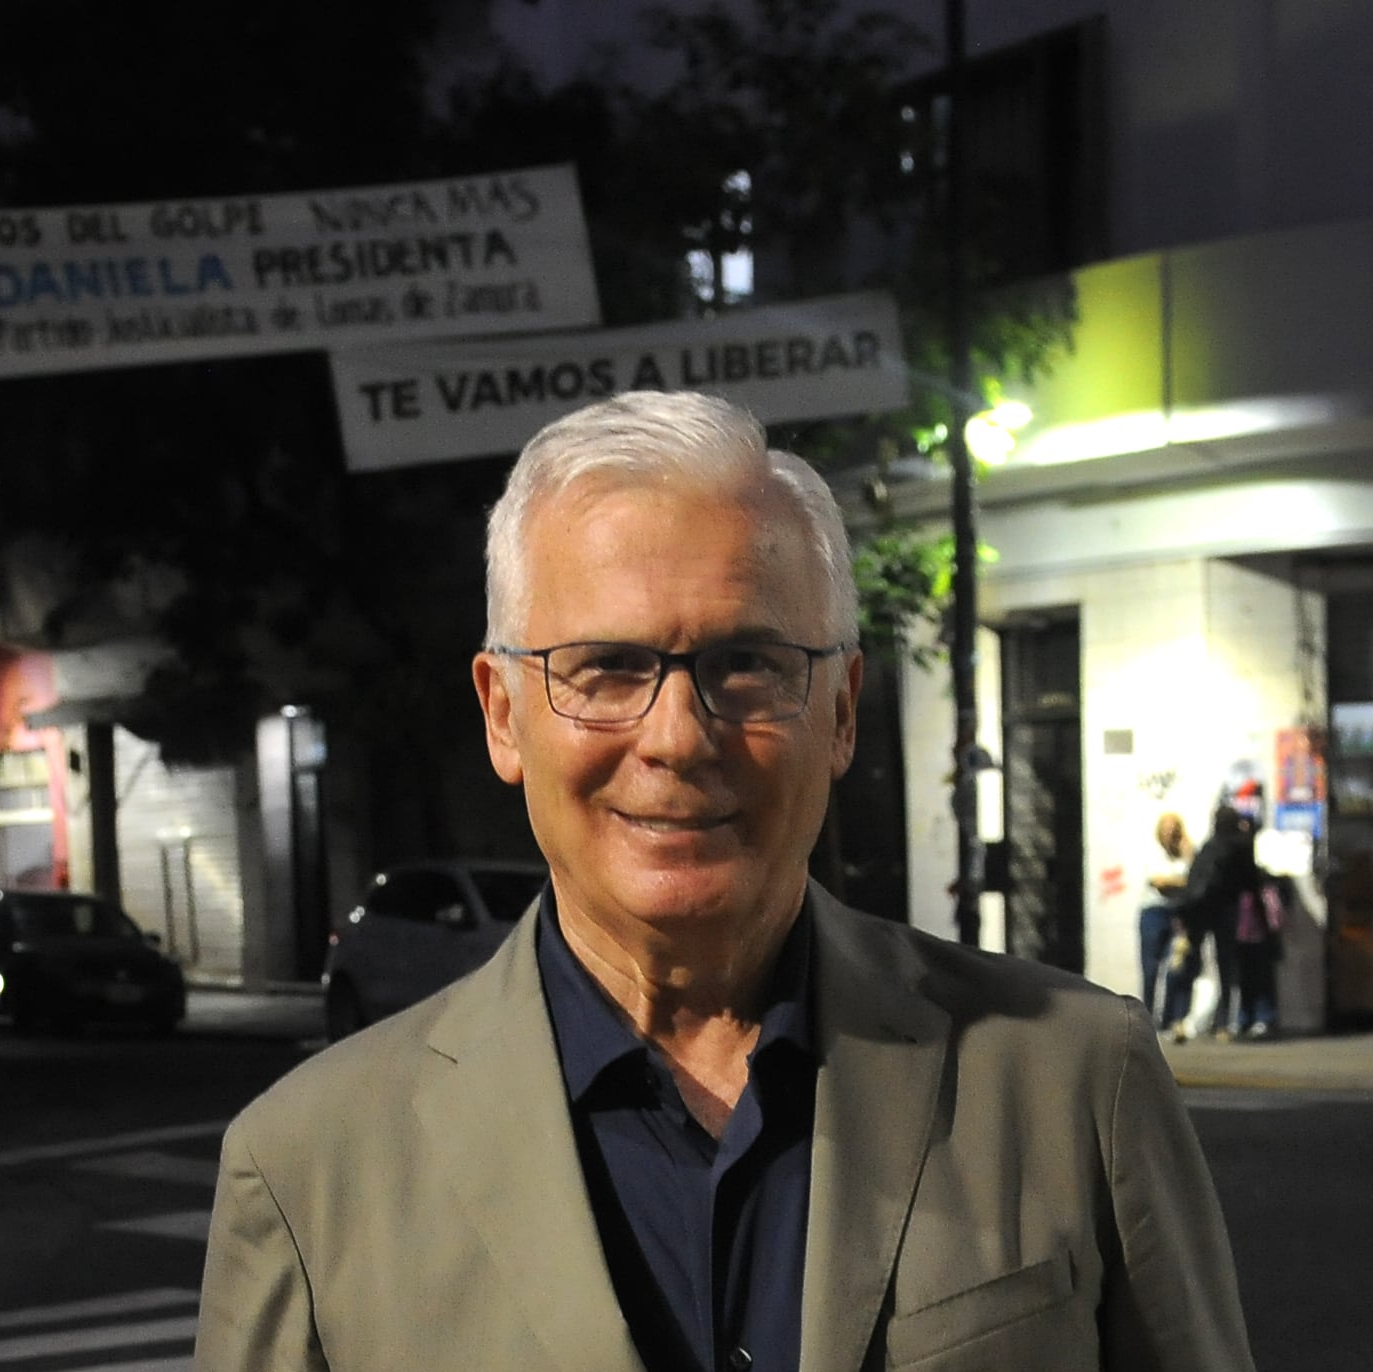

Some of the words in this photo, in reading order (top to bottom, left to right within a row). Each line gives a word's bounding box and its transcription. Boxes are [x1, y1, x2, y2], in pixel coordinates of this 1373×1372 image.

[68, 211, 130, 244] DEL
[251, 228, 518, 289] PRESIDENTA
[360, 378, 421, 421] TE
[435, 359, 617, 411] VAMOS
[632, 355, 667, 391] A
[680, 331, 882, 388] LIBERAR
